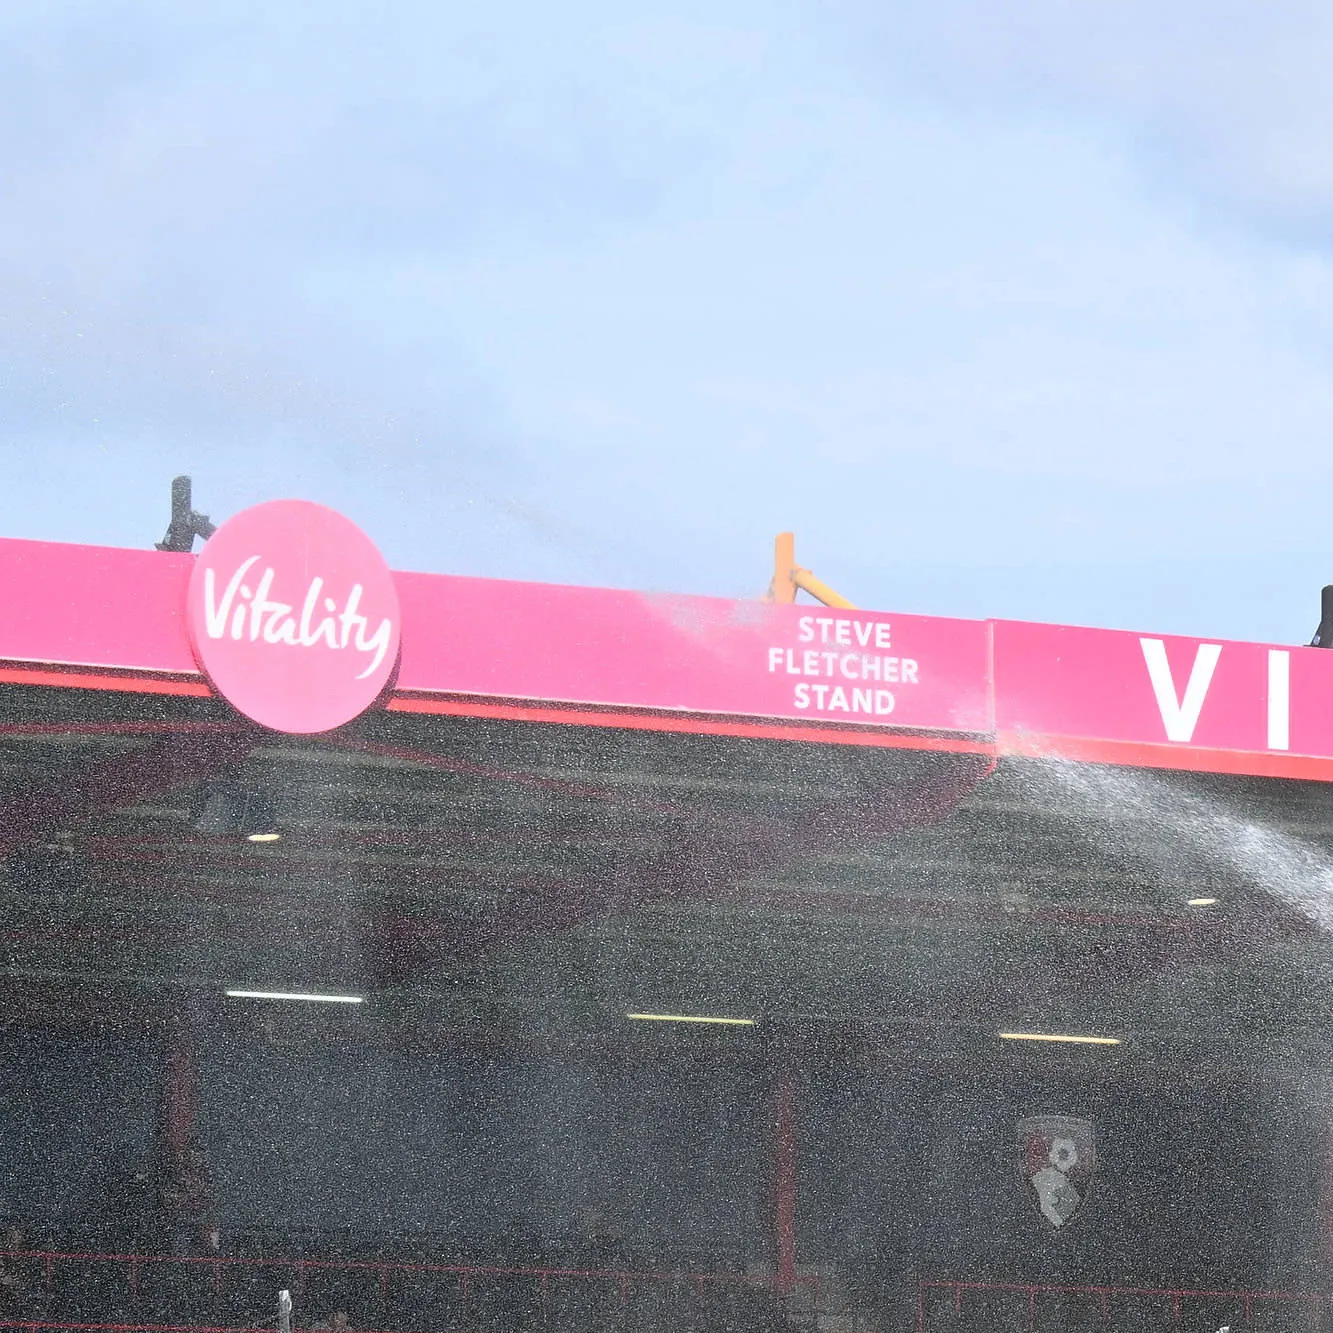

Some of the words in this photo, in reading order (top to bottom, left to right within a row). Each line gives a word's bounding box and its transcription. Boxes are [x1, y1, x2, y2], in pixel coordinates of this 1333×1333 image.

[205, 556, 391, 680] Vitality
[798, 616, 891, 648] STEVE
[768, 648, 919, 684] FLETCHER
[794, 683, 895, 715] STAND
